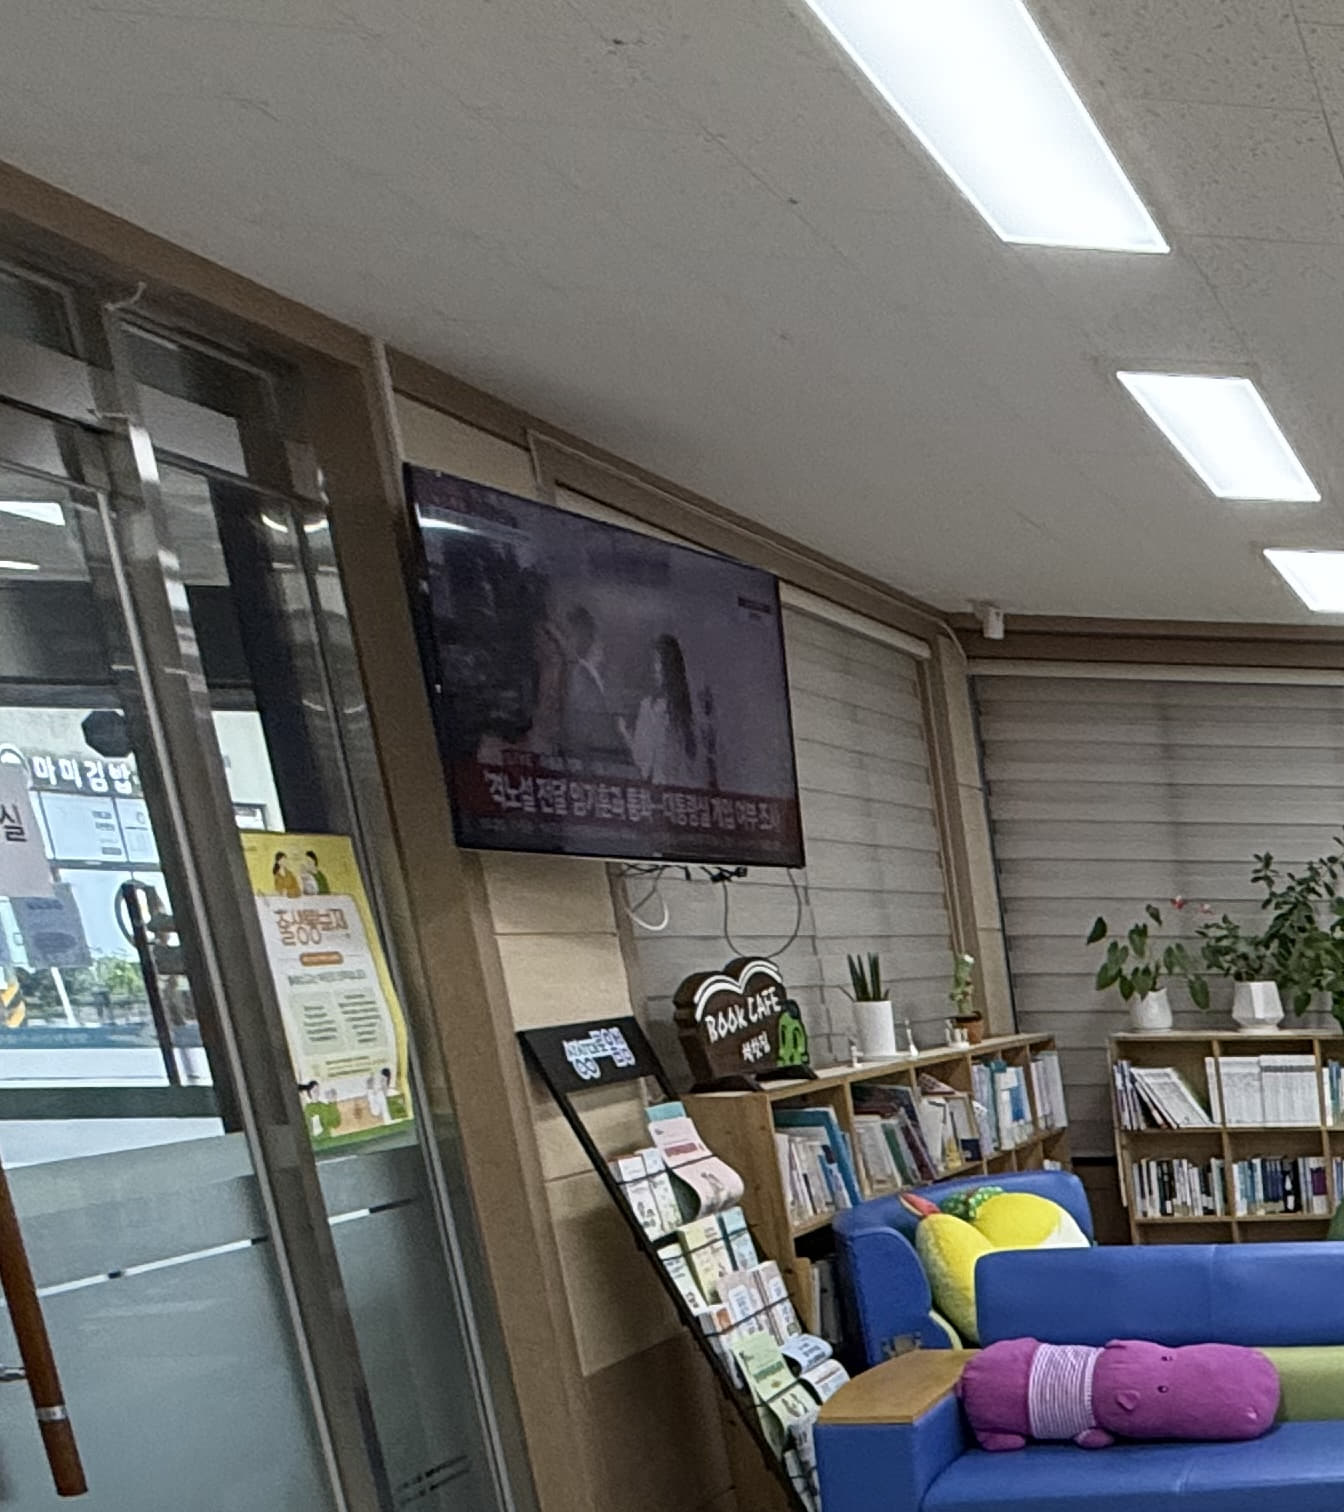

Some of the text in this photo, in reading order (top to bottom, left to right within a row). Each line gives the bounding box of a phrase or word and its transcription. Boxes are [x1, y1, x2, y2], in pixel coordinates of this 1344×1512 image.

[32, 755, 133, 795] 마미김밥
[705, 986, 783, 1043] BOOK CAFE
